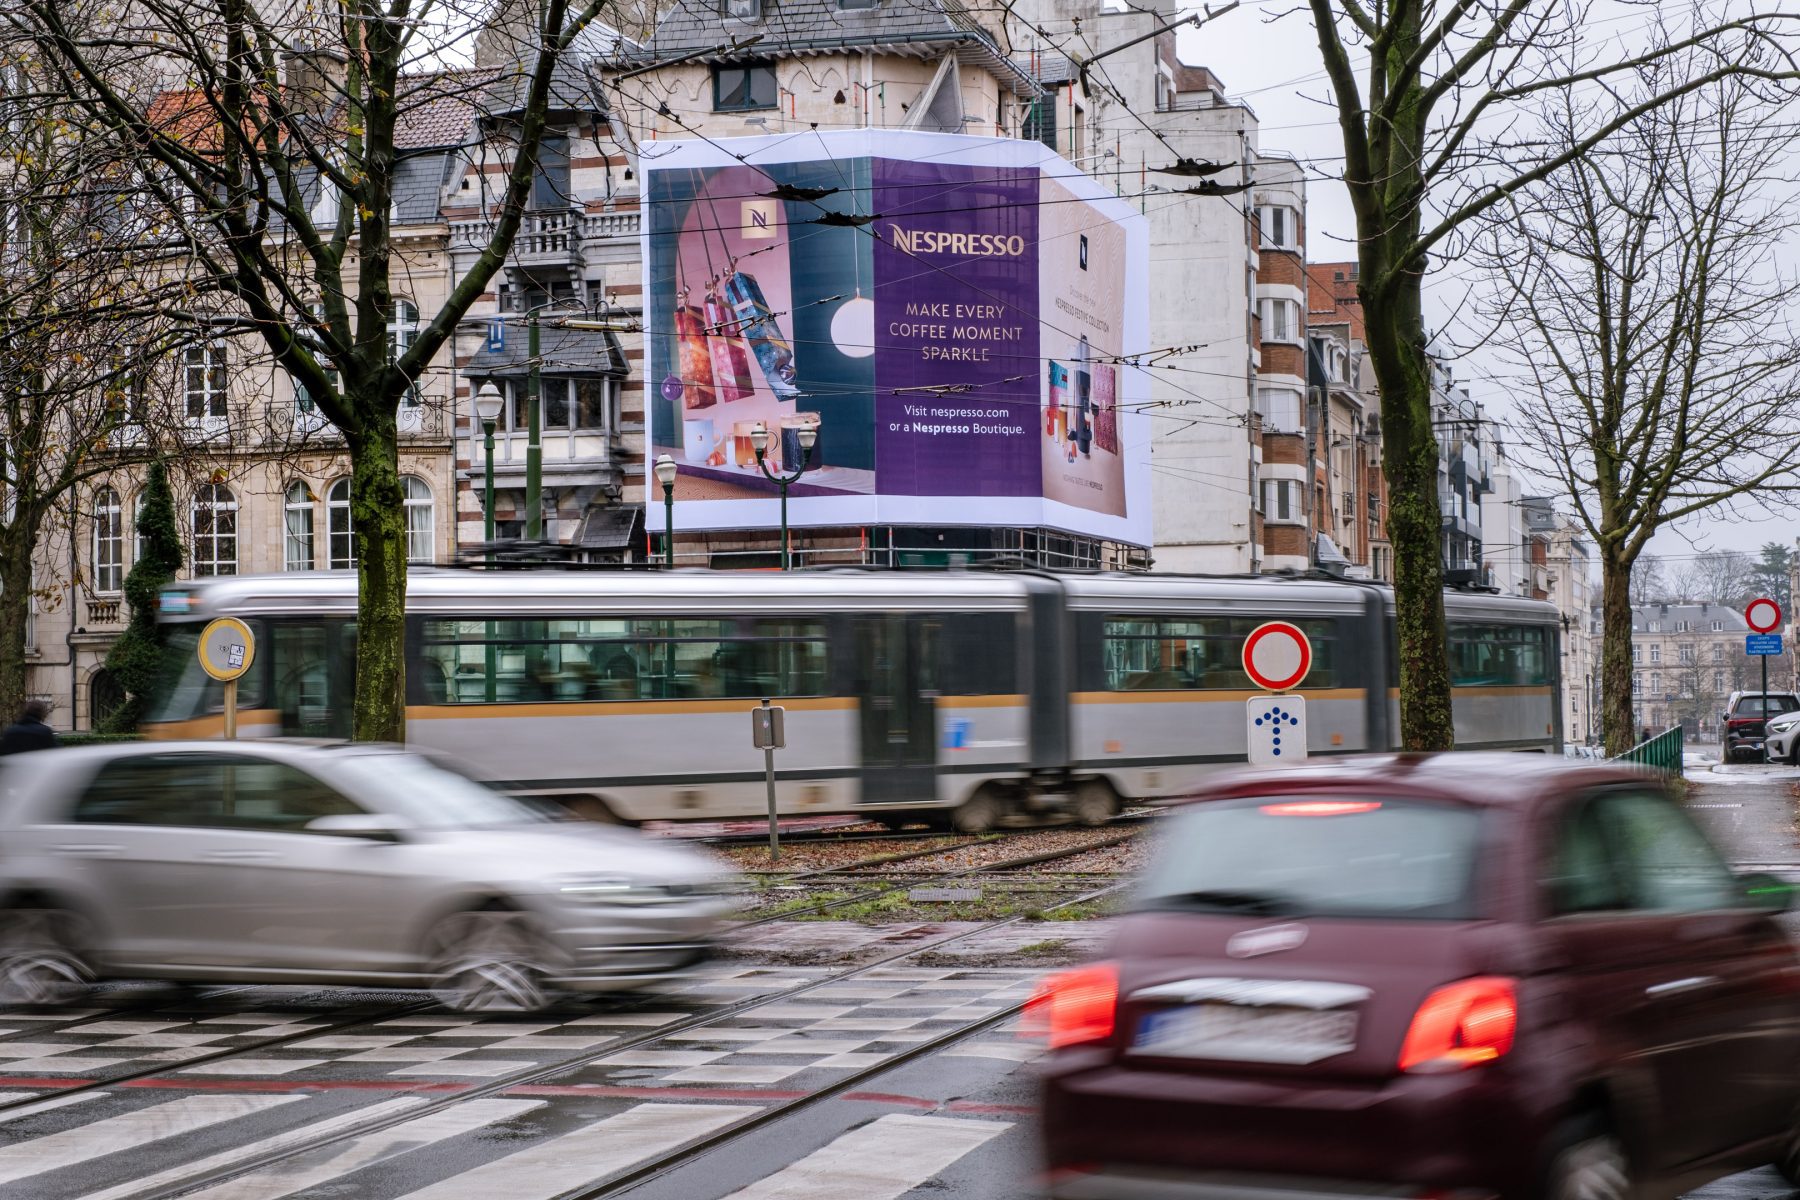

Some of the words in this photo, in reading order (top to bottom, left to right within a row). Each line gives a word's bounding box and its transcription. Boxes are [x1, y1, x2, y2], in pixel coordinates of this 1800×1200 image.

[887, 223, 1025, 256] NESPRESSO
[906, 302, 950, 318] MAKE
[956, 304, 1005, 319] EVERY
[889, 322, 947, 339] COFFEE
[952, 326, 1023, 340] MOMENT
[922, 346, 990, 361] SPARKLE
[904, 404, 927, 416] Visit
[931, 408, 1009, 420] nespresso.com
[889, 423, 900, 431] or
[903, 424, 910, 432] a
[912, 422, 970, 436] Nespresso
[973, 423, 1025, 437] Boutique.
